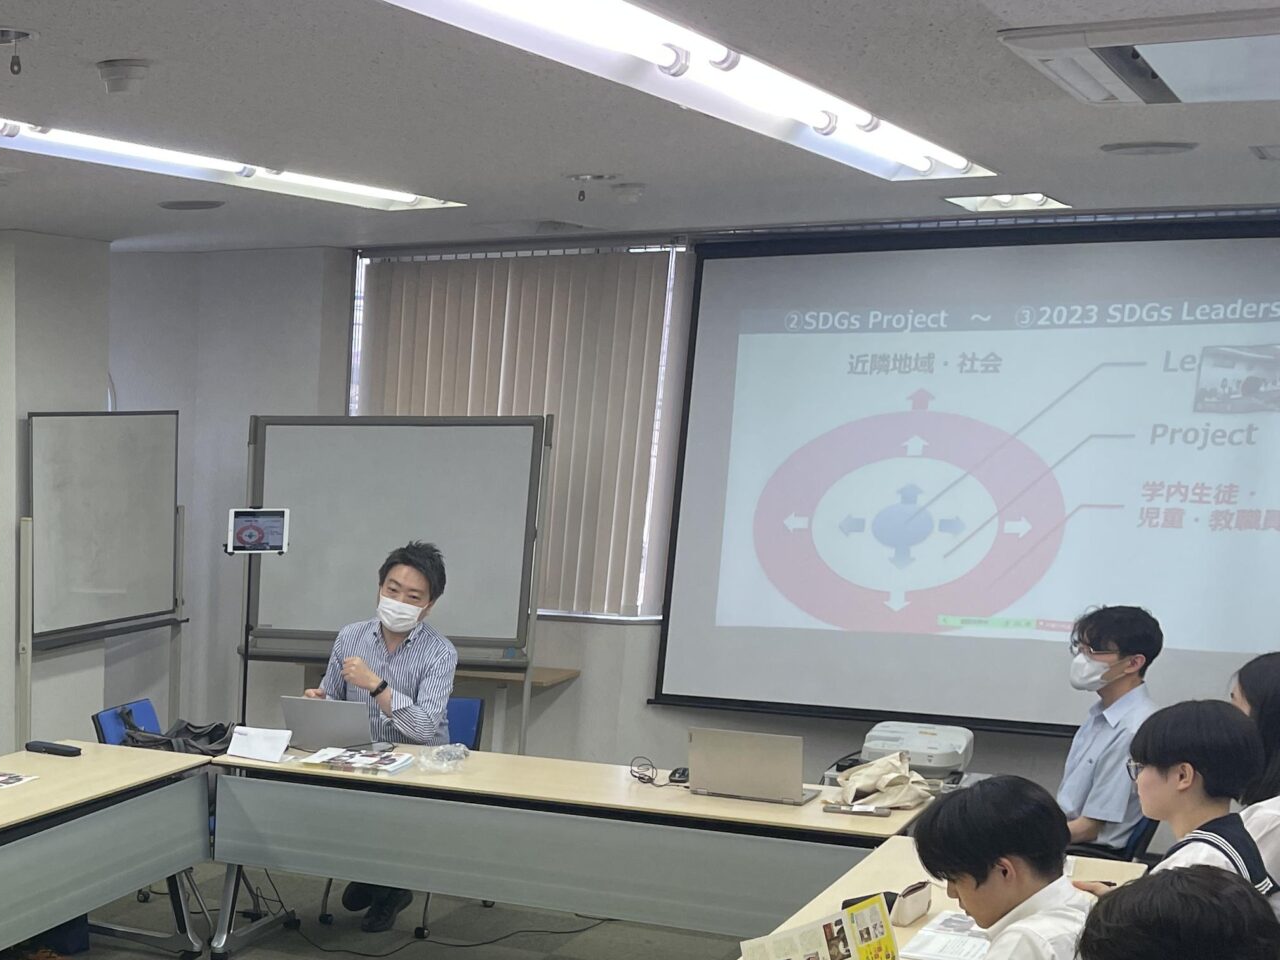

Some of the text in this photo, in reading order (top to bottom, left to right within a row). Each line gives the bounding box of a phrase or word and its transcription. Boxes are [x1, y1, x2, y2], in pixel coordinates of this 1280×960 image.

[868, 308, 949, 333] Project
[1106, 302, 1173, 324] SDGs
[847, 352, 1003, 375] 近隣地域・社会
[1150, 422, 1259, 451] Project
